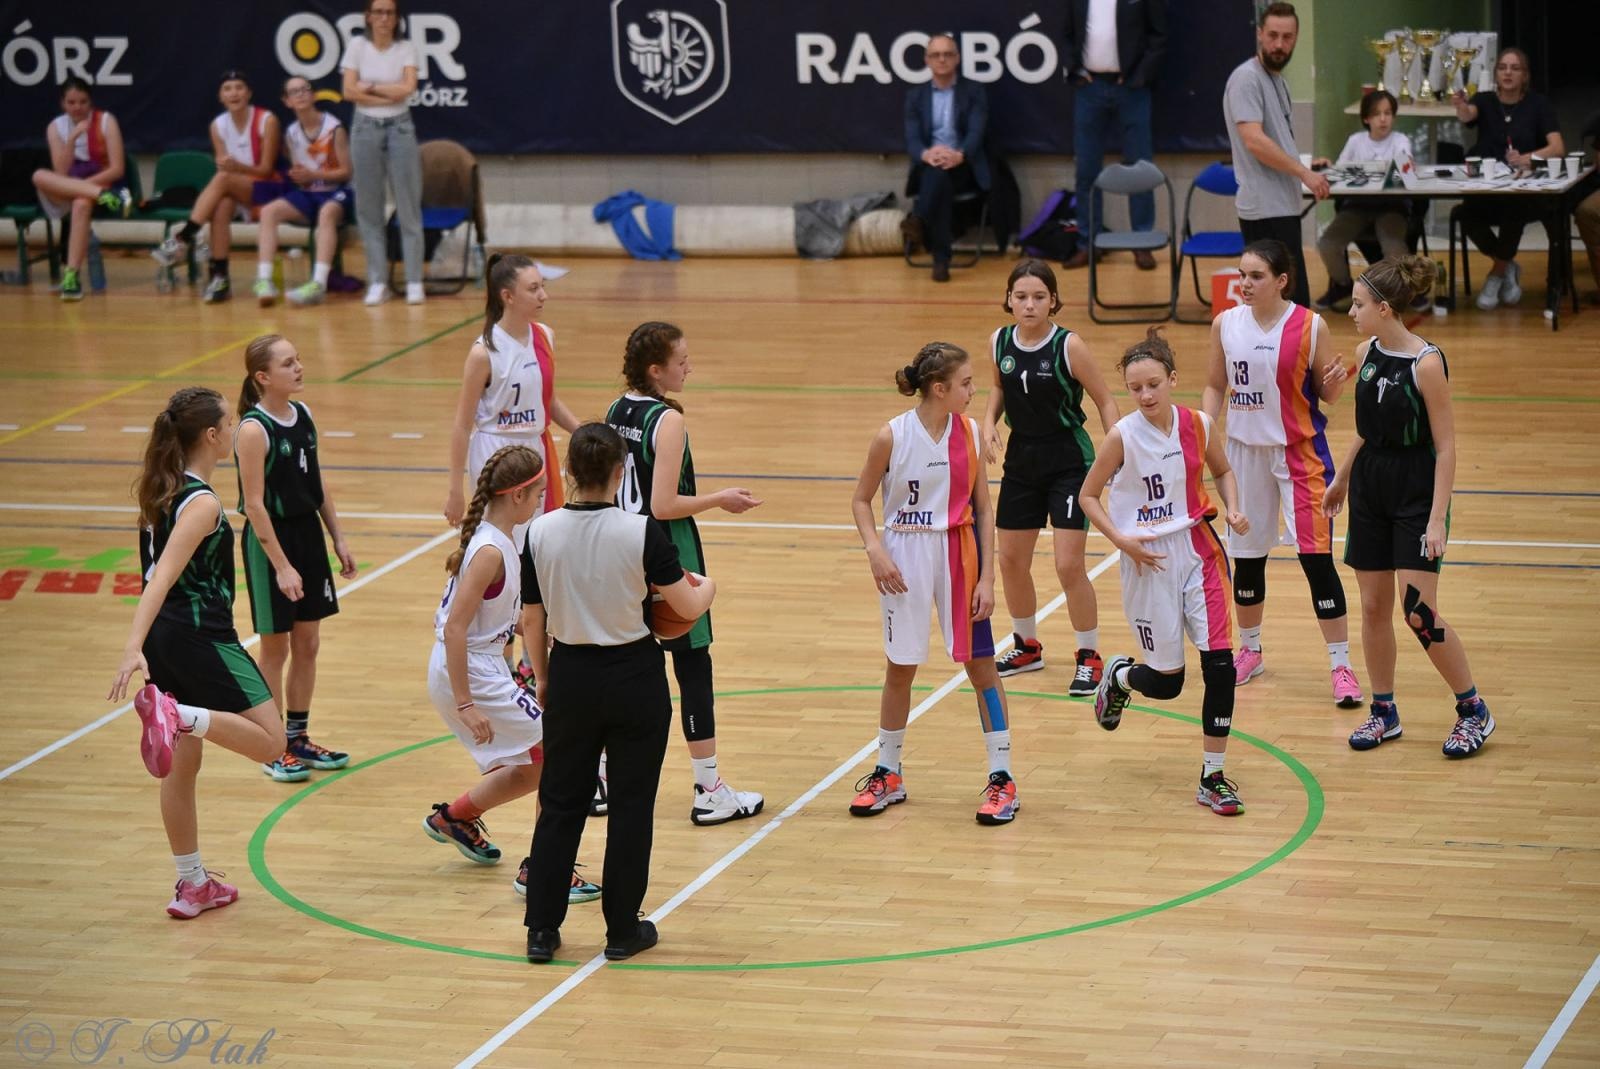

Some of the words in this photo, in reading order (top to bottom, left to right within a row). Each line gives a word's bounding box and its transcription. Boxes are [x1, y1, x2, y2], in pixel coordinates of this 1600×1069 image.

[1019, 370, 1029, 394] 1
[1232, 360, 1249, 386] 13
[511, 382, 521, 406] 7
[1229, 390, 1265, 406] MINI
[497, 408, 537, 425] MINI
[299, 447, 308, 474] 4
[907, 479, 920, 506] 5
[1142, 473, 1166, 502] 16
[893, 509, 933, 526] MINI
[1065, 495, 1074, 519] 1
[1136, 502, 1174, 522] MINI
[324, 578, 334, 602] 4
[1322, 599, 1336, 609] NBA
[1137, 624, 1155, 652] 16
